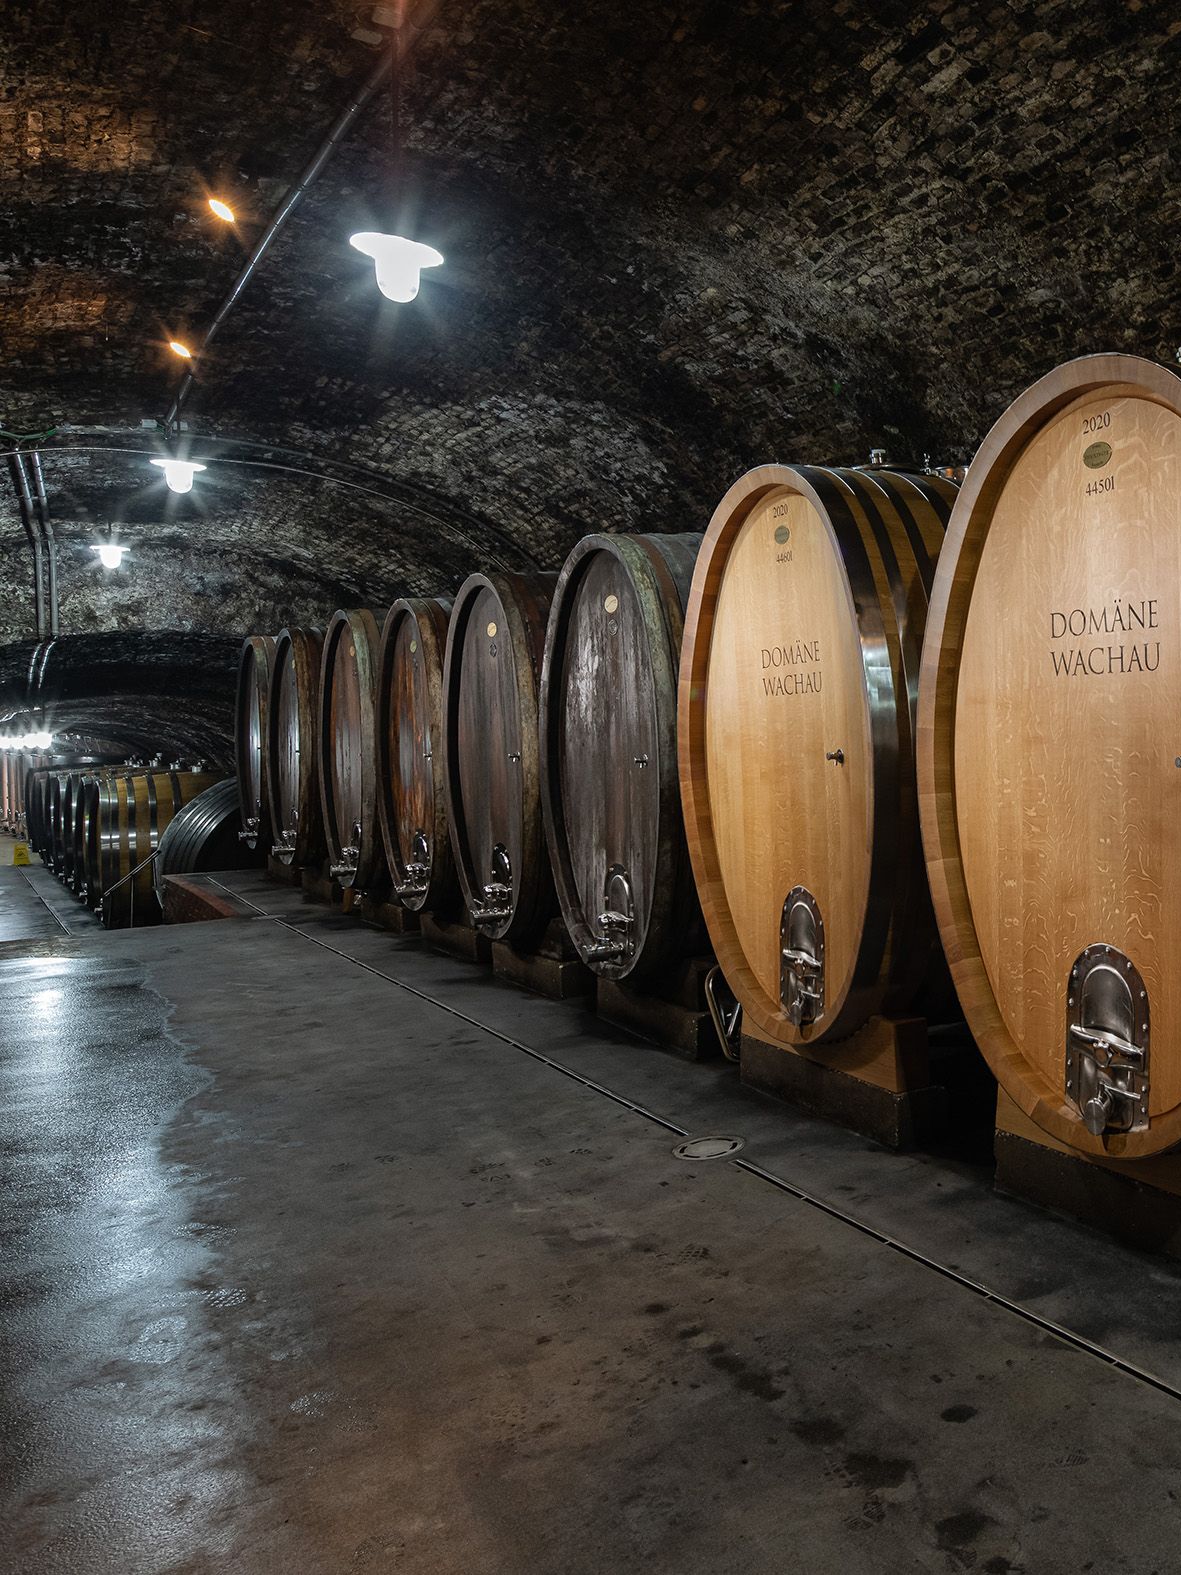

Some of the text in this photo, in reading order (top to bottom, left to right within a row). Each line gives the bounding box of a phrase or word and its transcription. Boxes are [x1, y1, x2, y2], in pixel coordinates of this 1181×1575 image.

[1082, 411, 1111, 434] 2020
[773, 503, 789, 518] 2020
[1050, 599, 1159, 639] DOMÄNE
[761, 639, 821, 669] DOMÄNE
[1050, 642, 1161, 677] WACHAU
[762, 671, 823, 697] WACHAU
